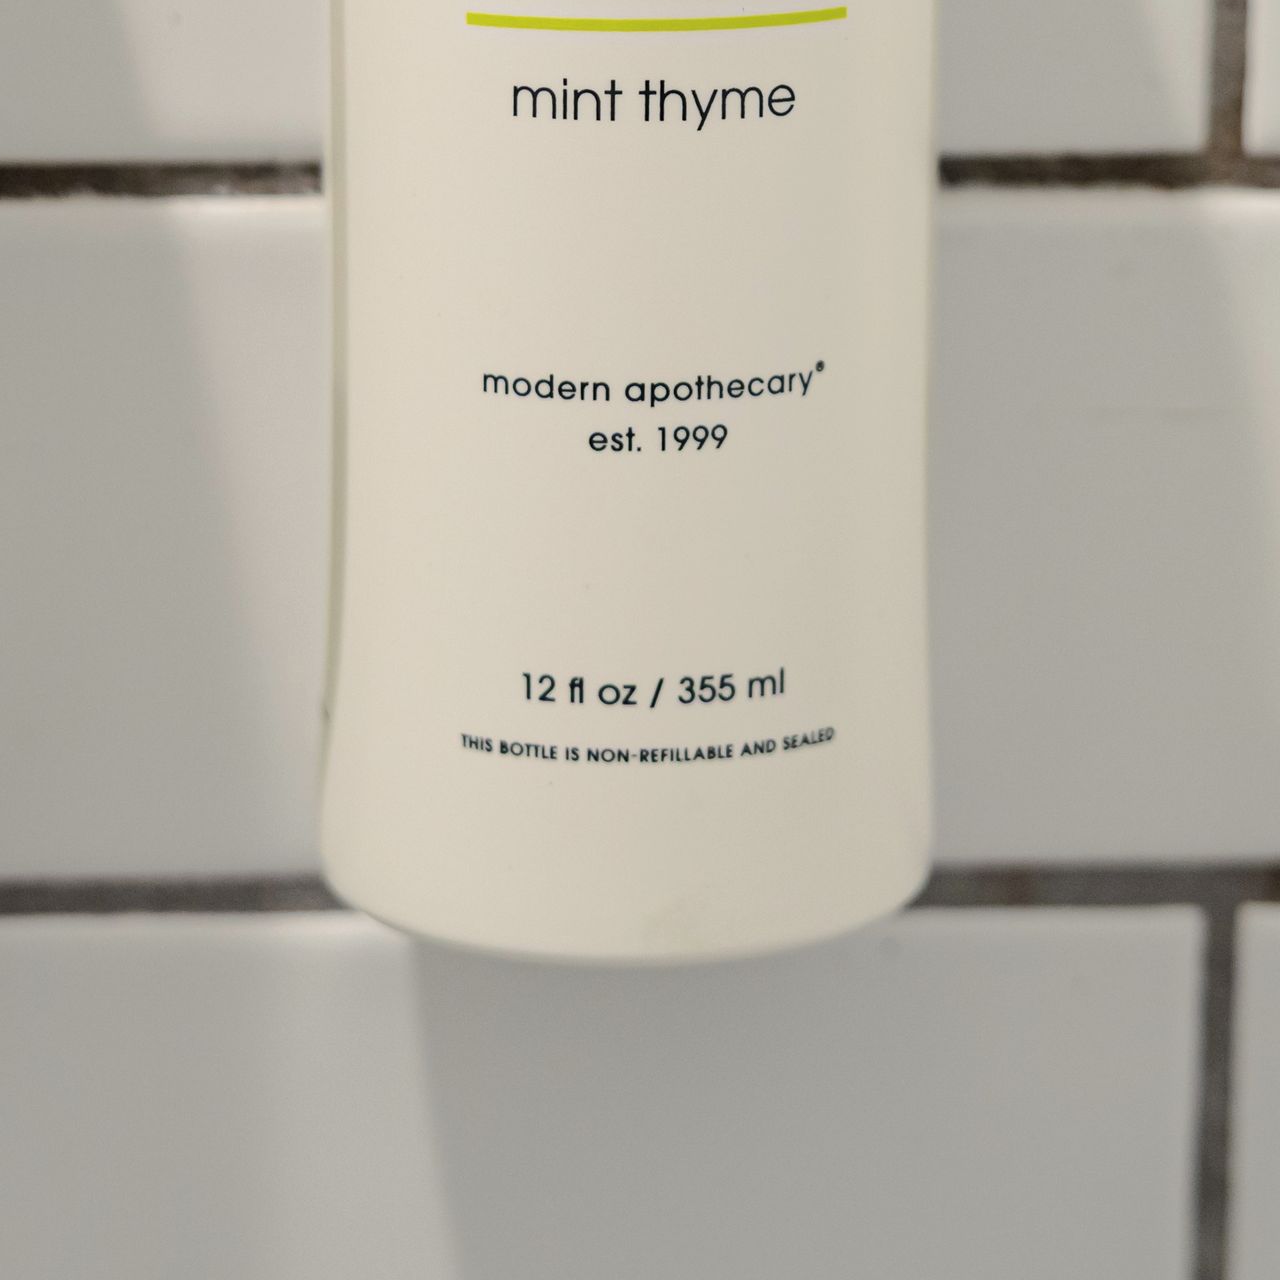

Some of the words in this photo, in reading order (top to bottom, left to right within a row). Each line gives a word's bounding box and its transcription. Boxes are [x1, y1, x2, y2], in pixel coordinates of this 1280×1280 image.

[513, 78, 623, 121] mint
[638, 80, 795, 131] thyme
[483, 373, 610, 402] modern
[588, 427, 642, 452] est.
[658, 424, 728, 452] 1999
[522, 672, 556, 703] 12
[568, 676, 584, 704] fl
[597, 683, 637, 706] oz
[649, 677, 664, 709] /
[678, 673, 736, 705] 355
[748, 667, 785, 699] ml
[461, 733, 493, 753] THIS
[499, 740, 557, 760] BOTTLE
[565, 747, 580, 762] IS
[586, 744, 733, 763] NON-REFILLABLE
[740, 739, 777, 757] AND
[782, 727, 835, 751] SEALED
